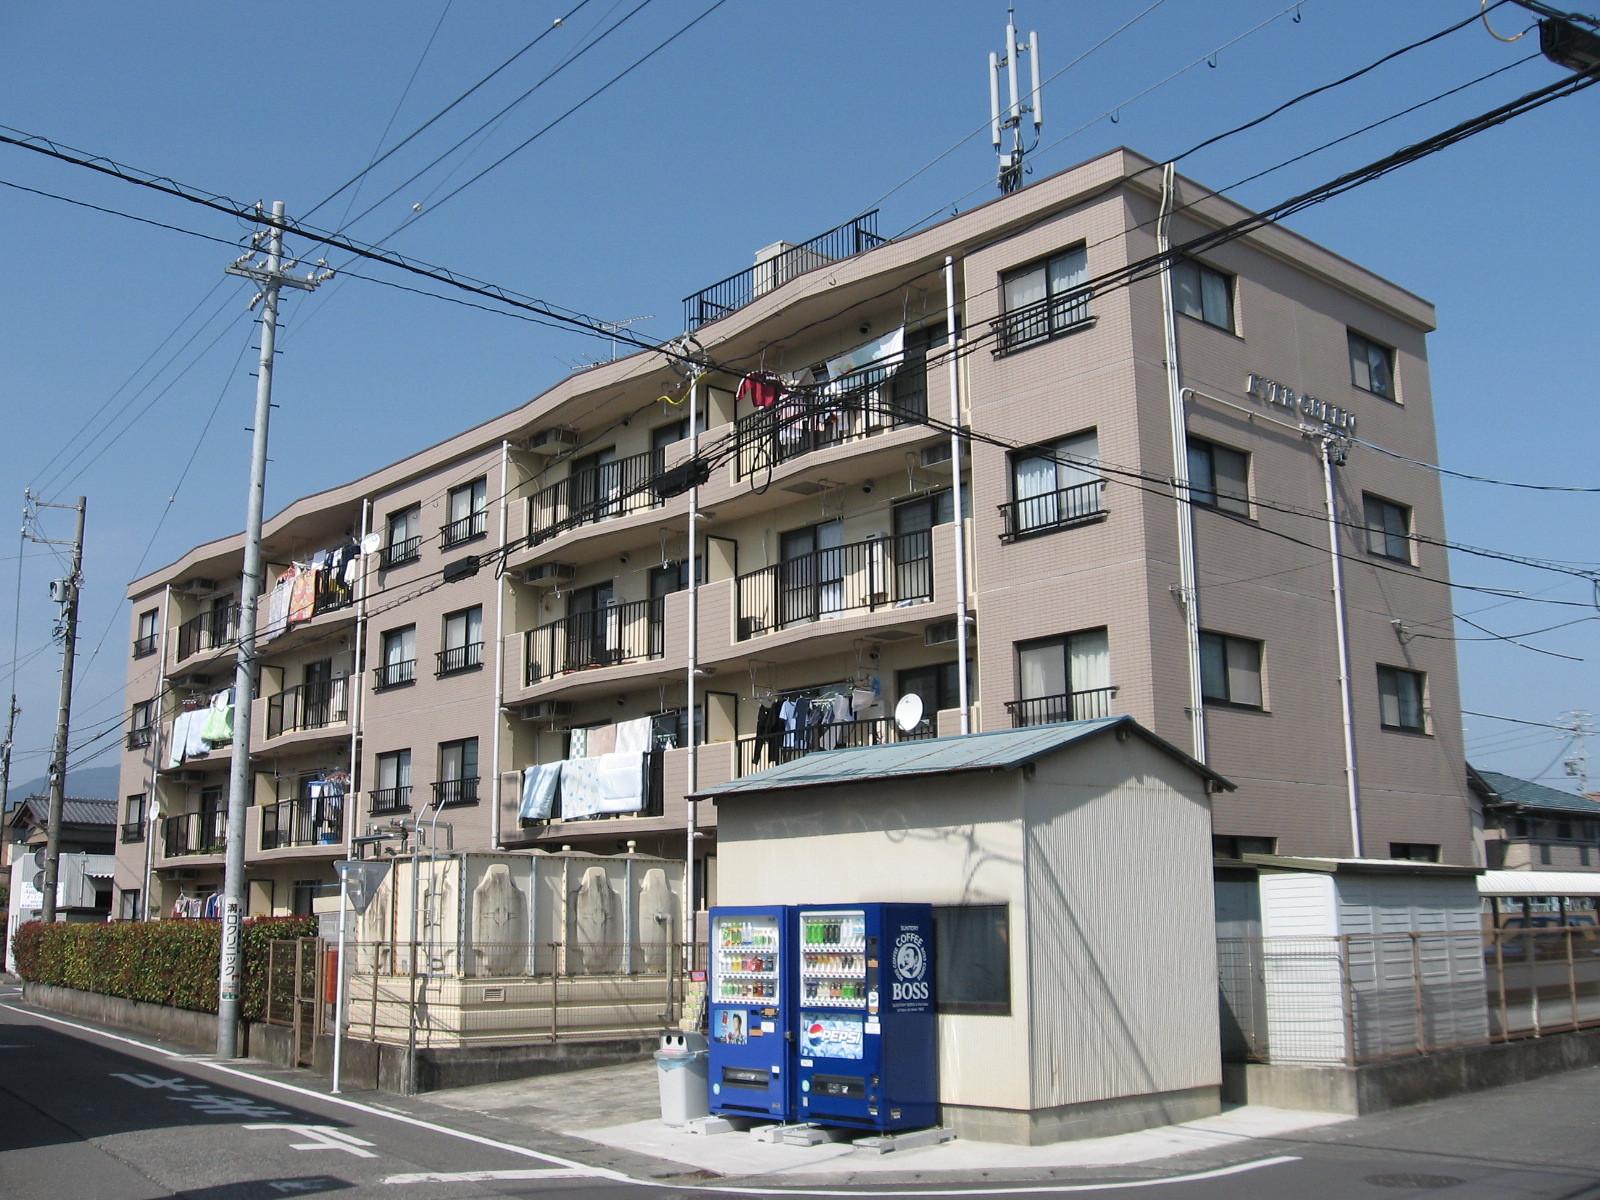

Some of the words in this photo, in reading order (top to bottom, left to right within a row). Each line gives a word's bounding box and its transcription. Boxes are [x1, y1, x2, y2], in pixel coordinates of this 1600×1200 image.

[895, 932, 923, 948] COFFEE
[892, 982, 929, 1000] BOSS
[823, 1030, 862, 1045] PEPSI
